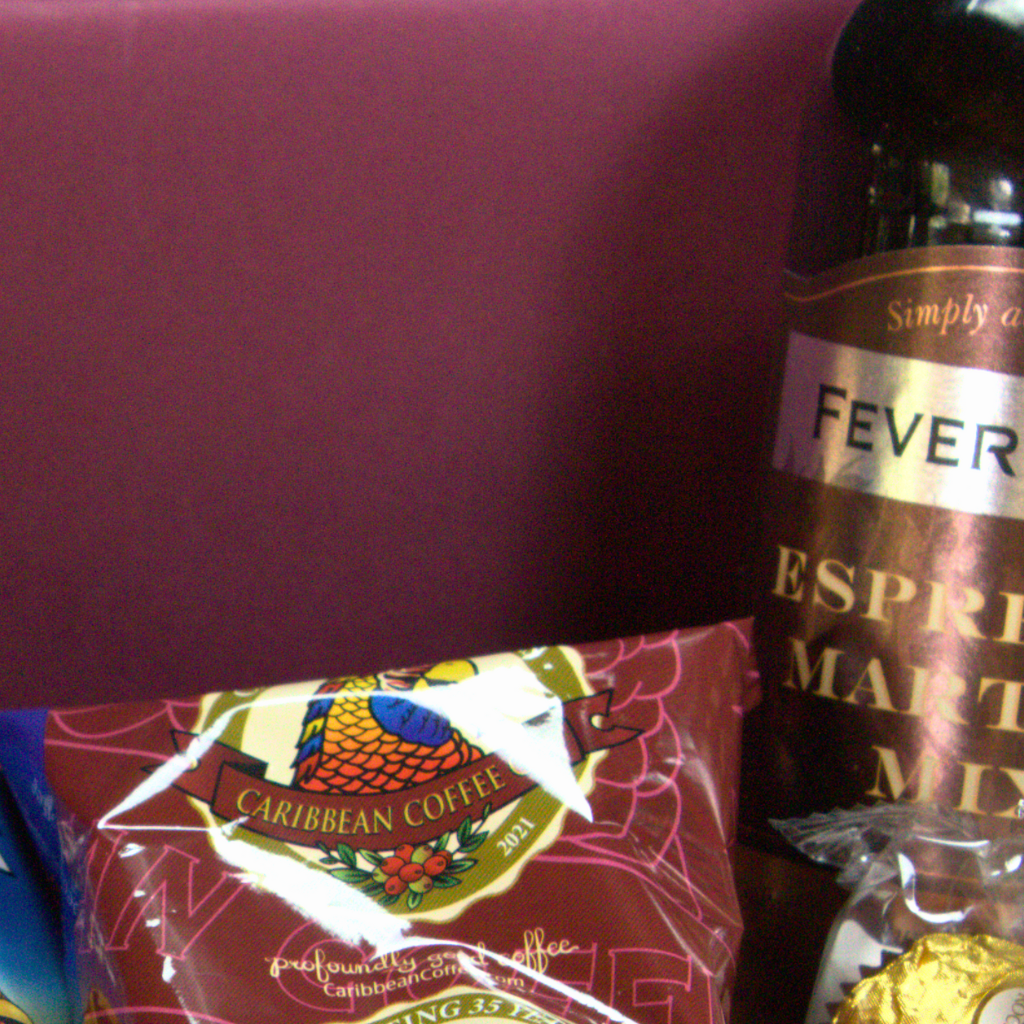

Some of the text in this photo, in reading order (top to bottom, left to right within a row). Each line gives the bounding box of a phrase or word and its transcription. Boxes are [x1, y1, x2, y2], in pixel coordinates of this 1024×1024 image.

[887, 294, 988, 336] Simply
[812, 383, 1019, 477] FEVER
[236, 765, 506, 836] CARIBBEAN COFFEE
[496, 816, 536, 858] 2021
[468, 998, 503, 1016] 35
